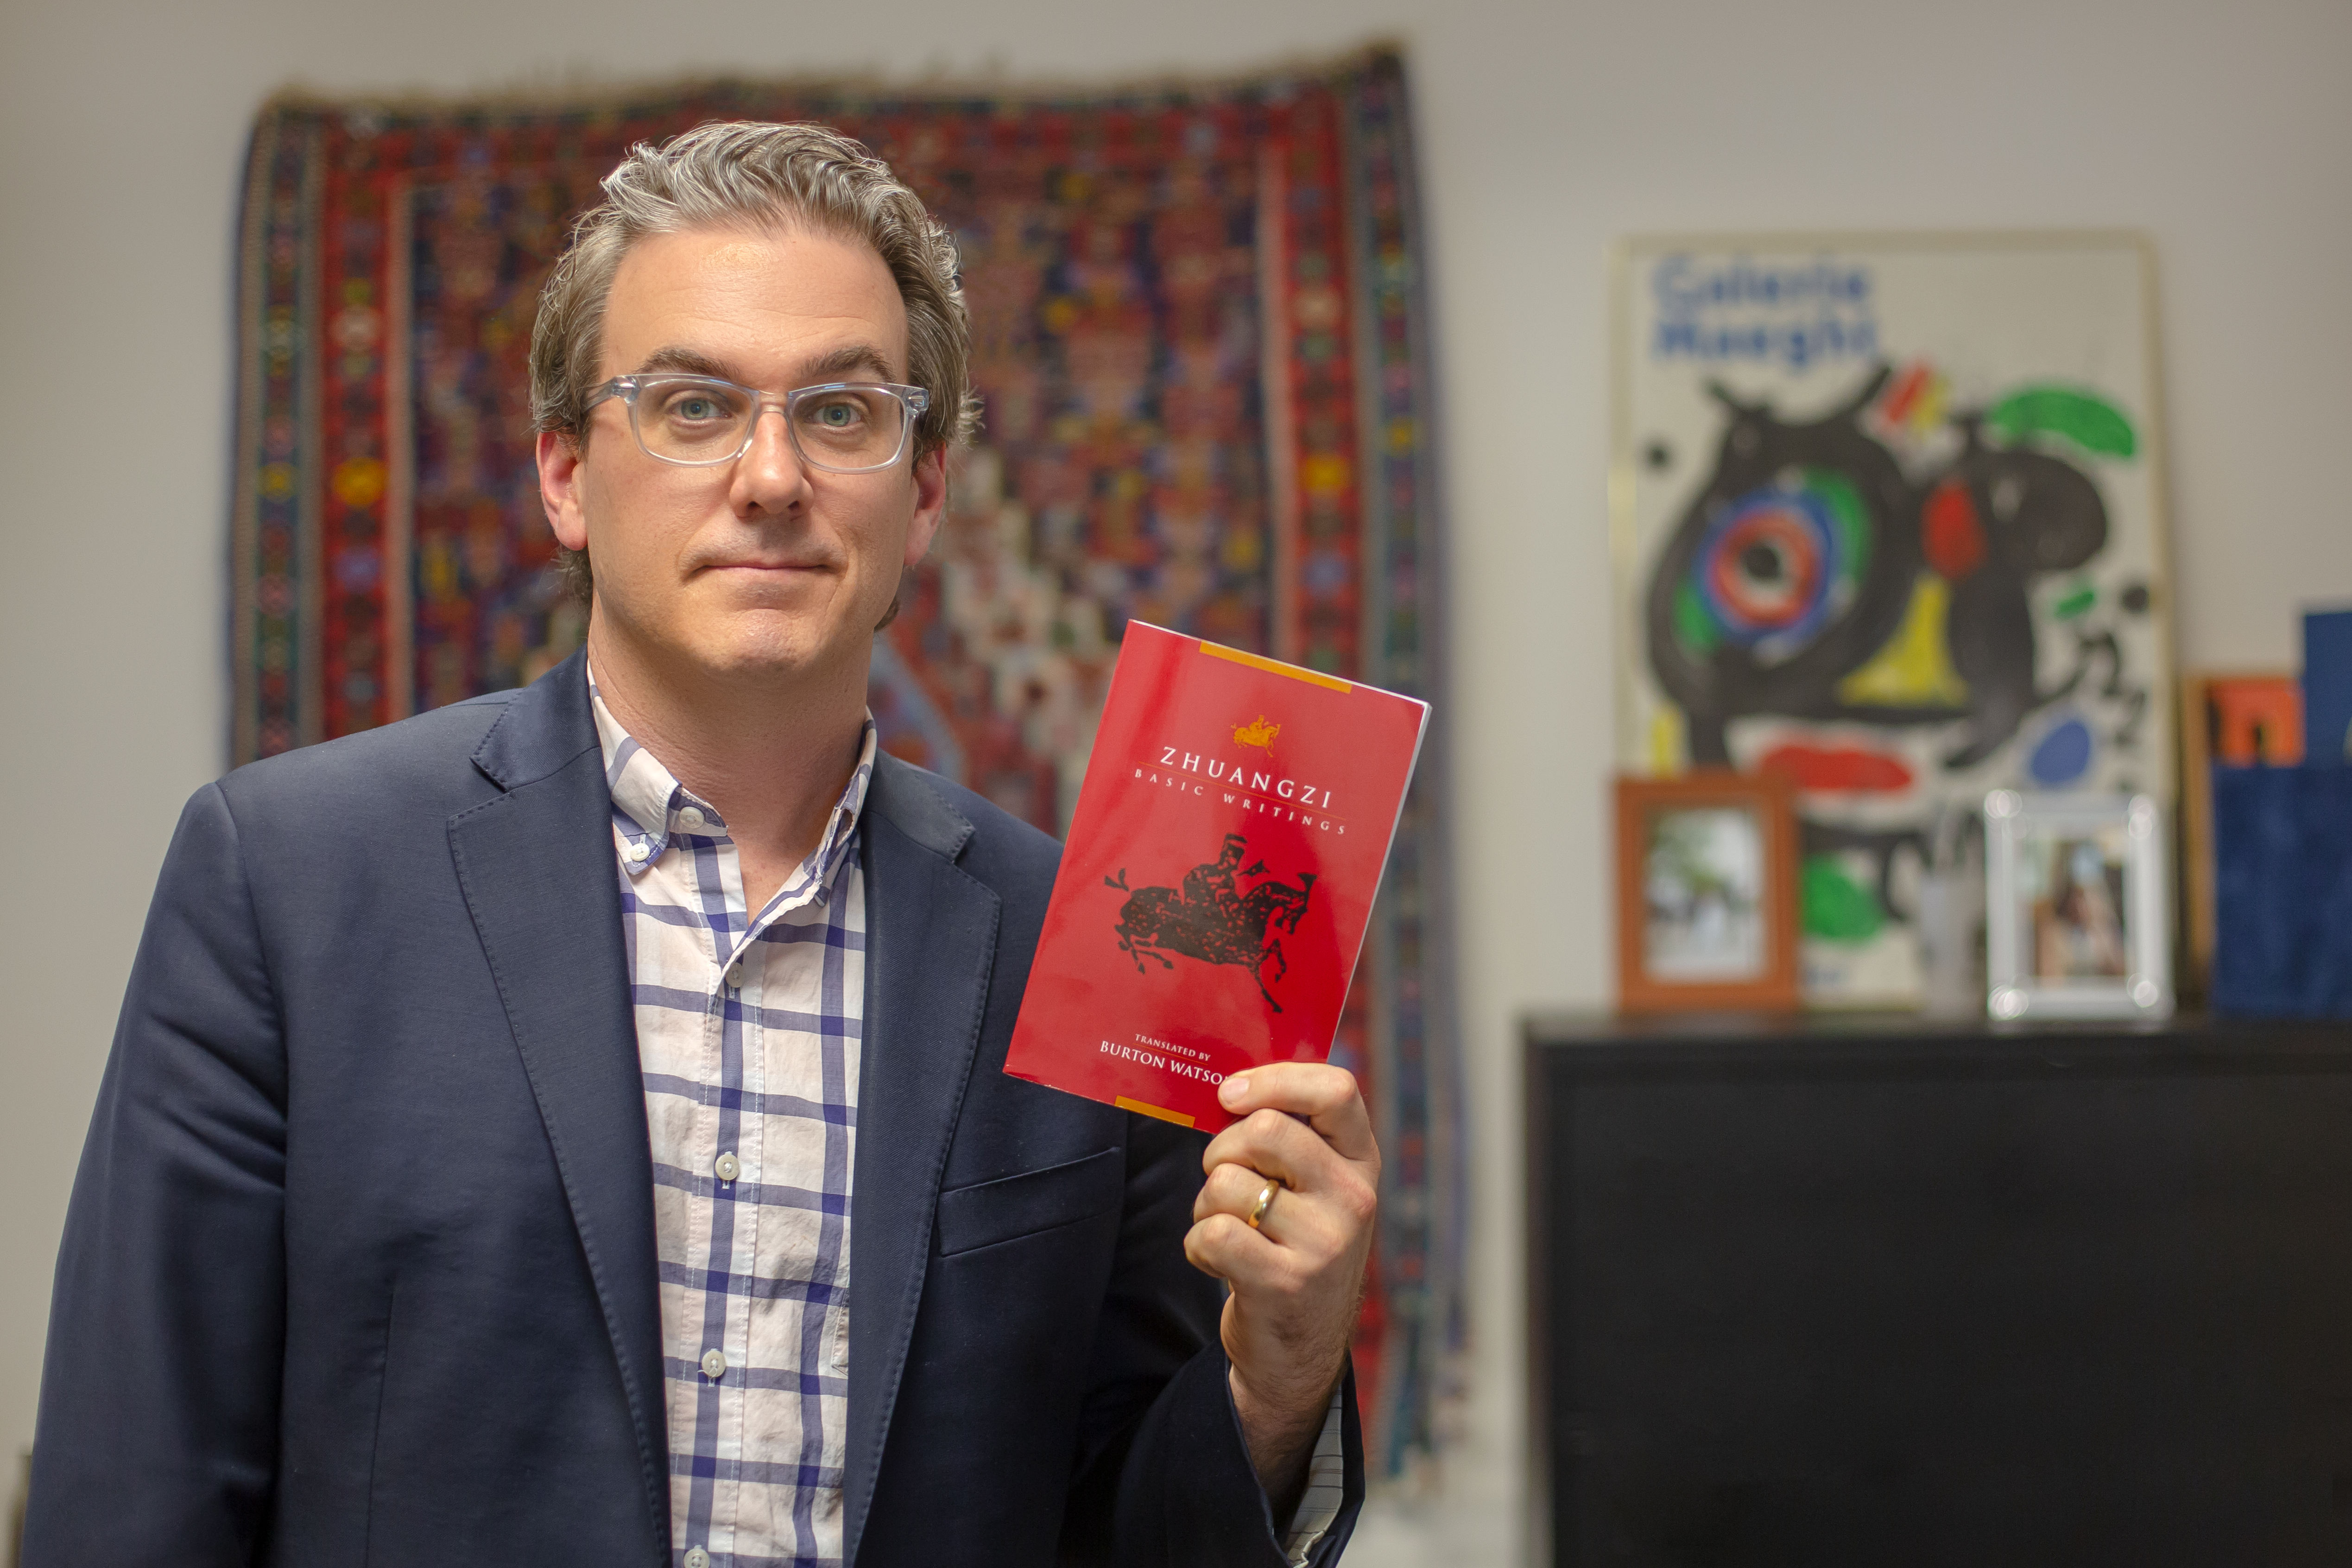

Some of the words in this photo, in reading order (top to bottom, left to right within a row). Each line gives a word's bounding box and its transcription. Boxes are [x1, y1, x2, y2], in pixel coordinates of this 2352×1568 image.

[1135, 768, 1204, 796] BASIC
[1223, 793, 1345, 835] WRITINGS
[1160, 746, 1331, 809] ZHUANGZI
[1100, 1041, 1165, 1069] BURTON
[1170, 1060, 1228, 1085] WATSO
[1135, 1034, 1196, 1057] TRANSLATED
[1199, 1052, 1211, 1062] BY
